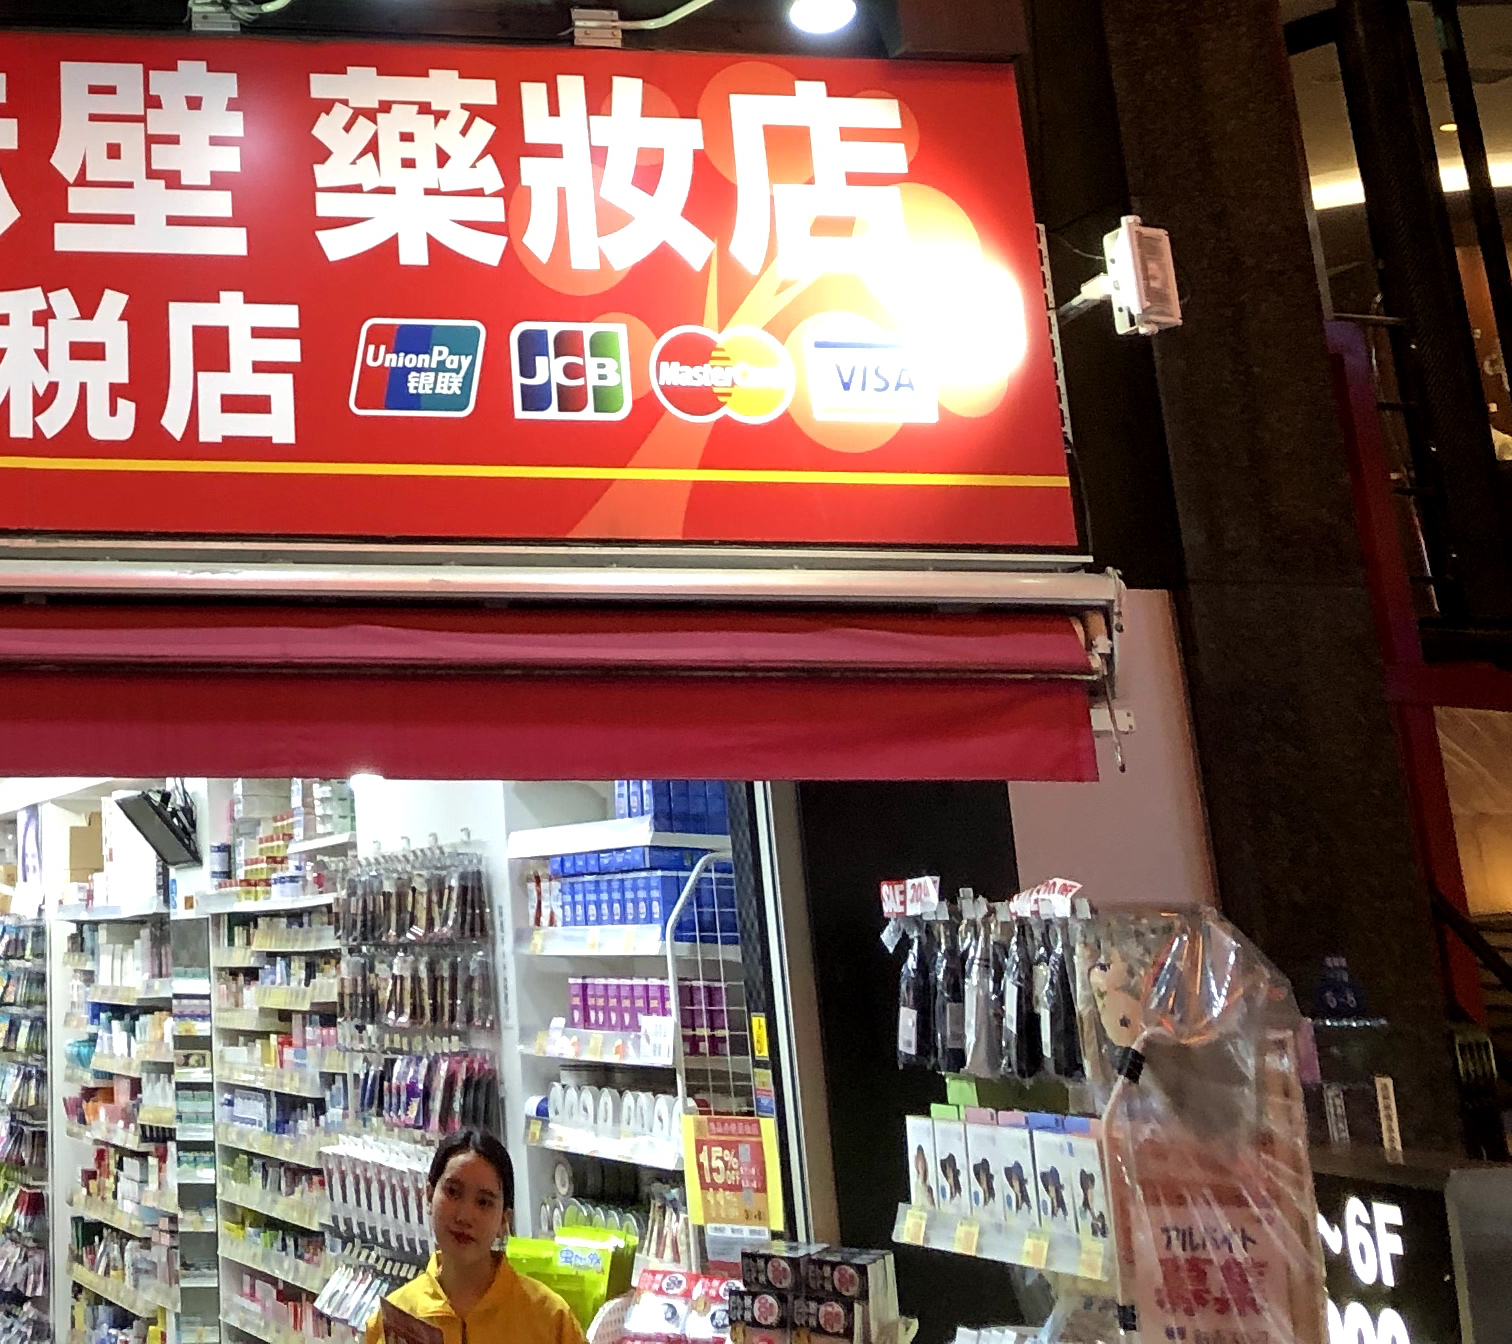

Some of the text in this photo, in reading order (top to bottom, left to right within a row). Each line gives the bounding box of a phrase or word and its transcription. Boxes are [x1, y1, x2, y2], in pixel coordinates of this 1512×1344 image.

[366, 343, 473, 380] UnionPay
[513, 356, 622, 388] JCB
[658, 360, 785, 390] MasterC
[406, 372, 464, 396] 银联
[835, 364, 915, 394] VISA
[699, 1145, 739, 1185] 15%
